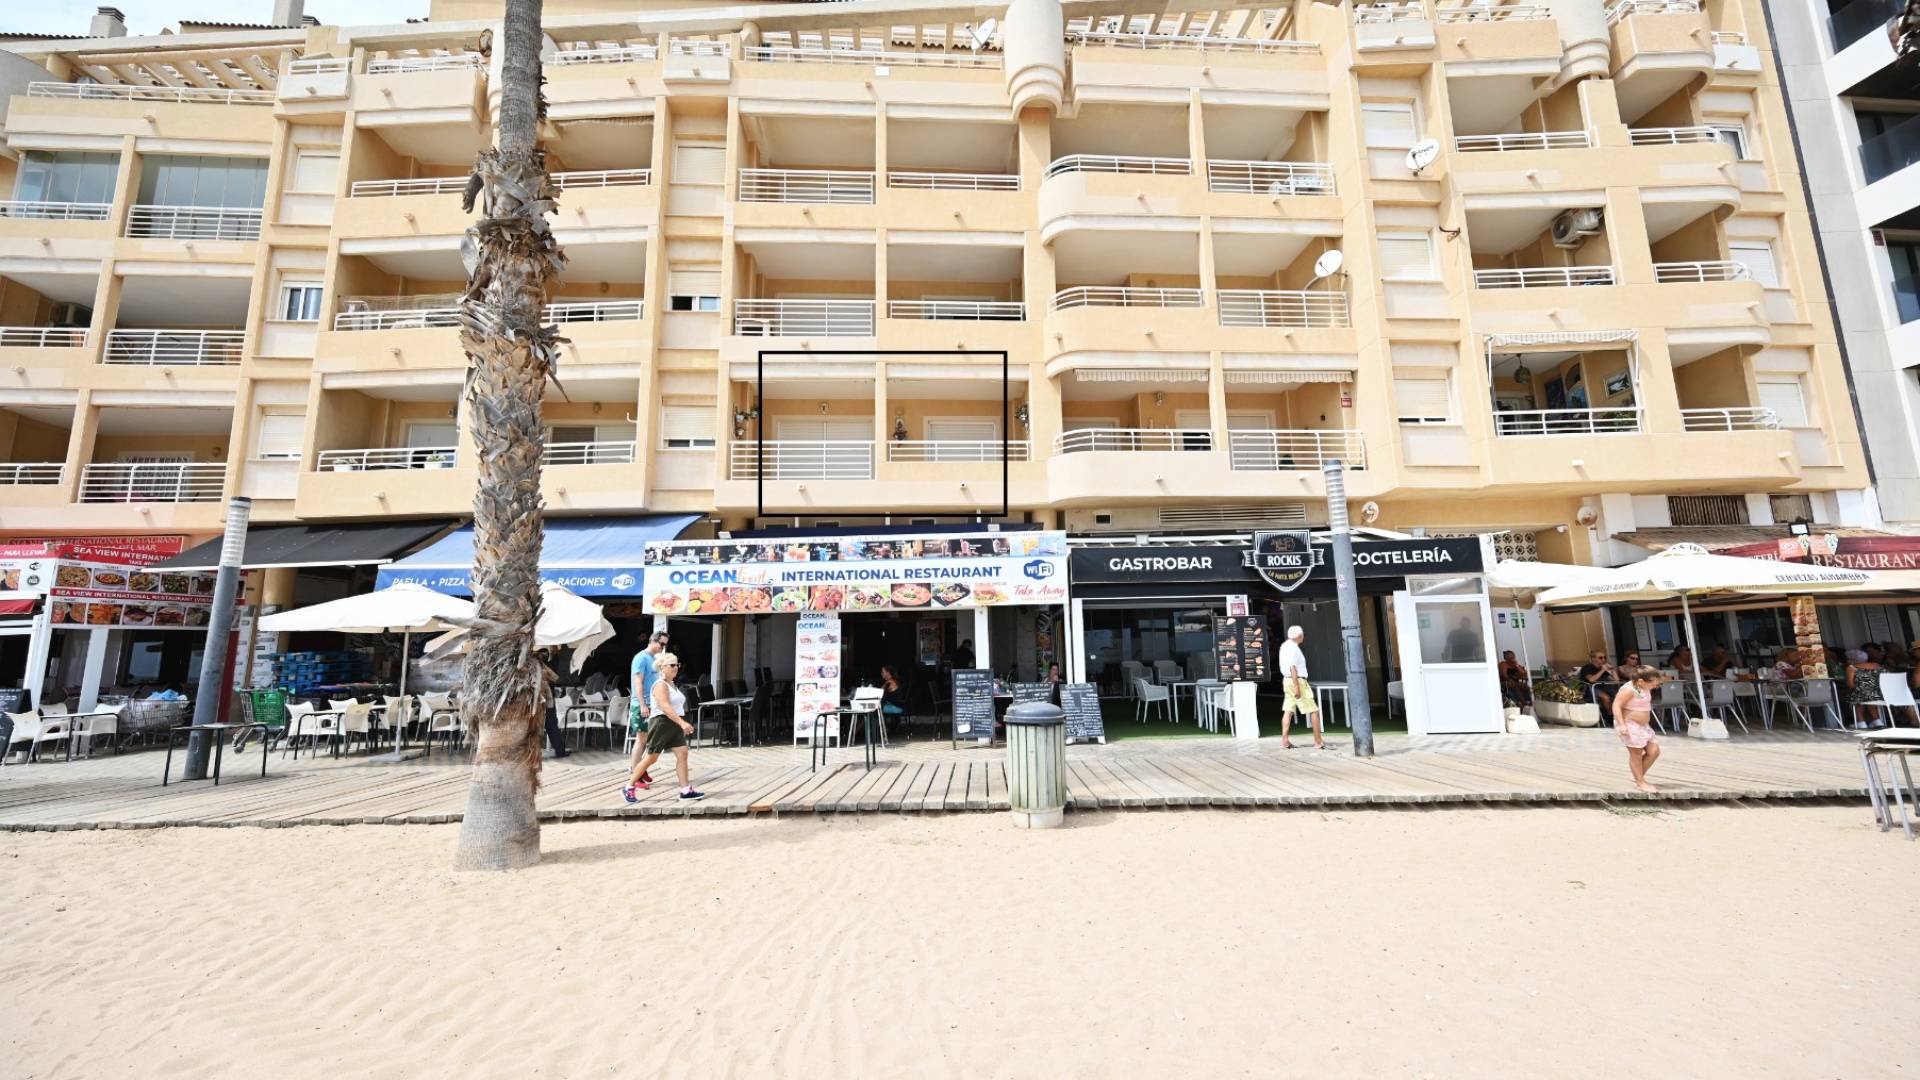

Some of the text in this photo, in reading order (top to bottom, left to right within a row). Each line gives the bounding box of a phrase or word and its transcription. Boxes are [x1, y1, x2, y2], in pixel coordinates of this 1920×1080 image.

[73, 546, 92, 554] SEA
[95, 548, 119, 558] VIEW
[1109, 556, 1213, 571] GASTROBAR
[1267, 554, 1302, 566] ROCKIS
[438, 576, 465, 587] PIZZA
[558, 576, 606, 587] RACIONES
[669, 570, 738, 585] OCEAN
[781, 567, 900, 583] INTERNATIONAL
[904, 566, 1003, 580] RESTAURANT
[1775, 574, 1819, 583] CERVEZAS
[94, 591, 151, 601] INTERNATIONAL
[1013, 583, 1066, 600] Take Away
